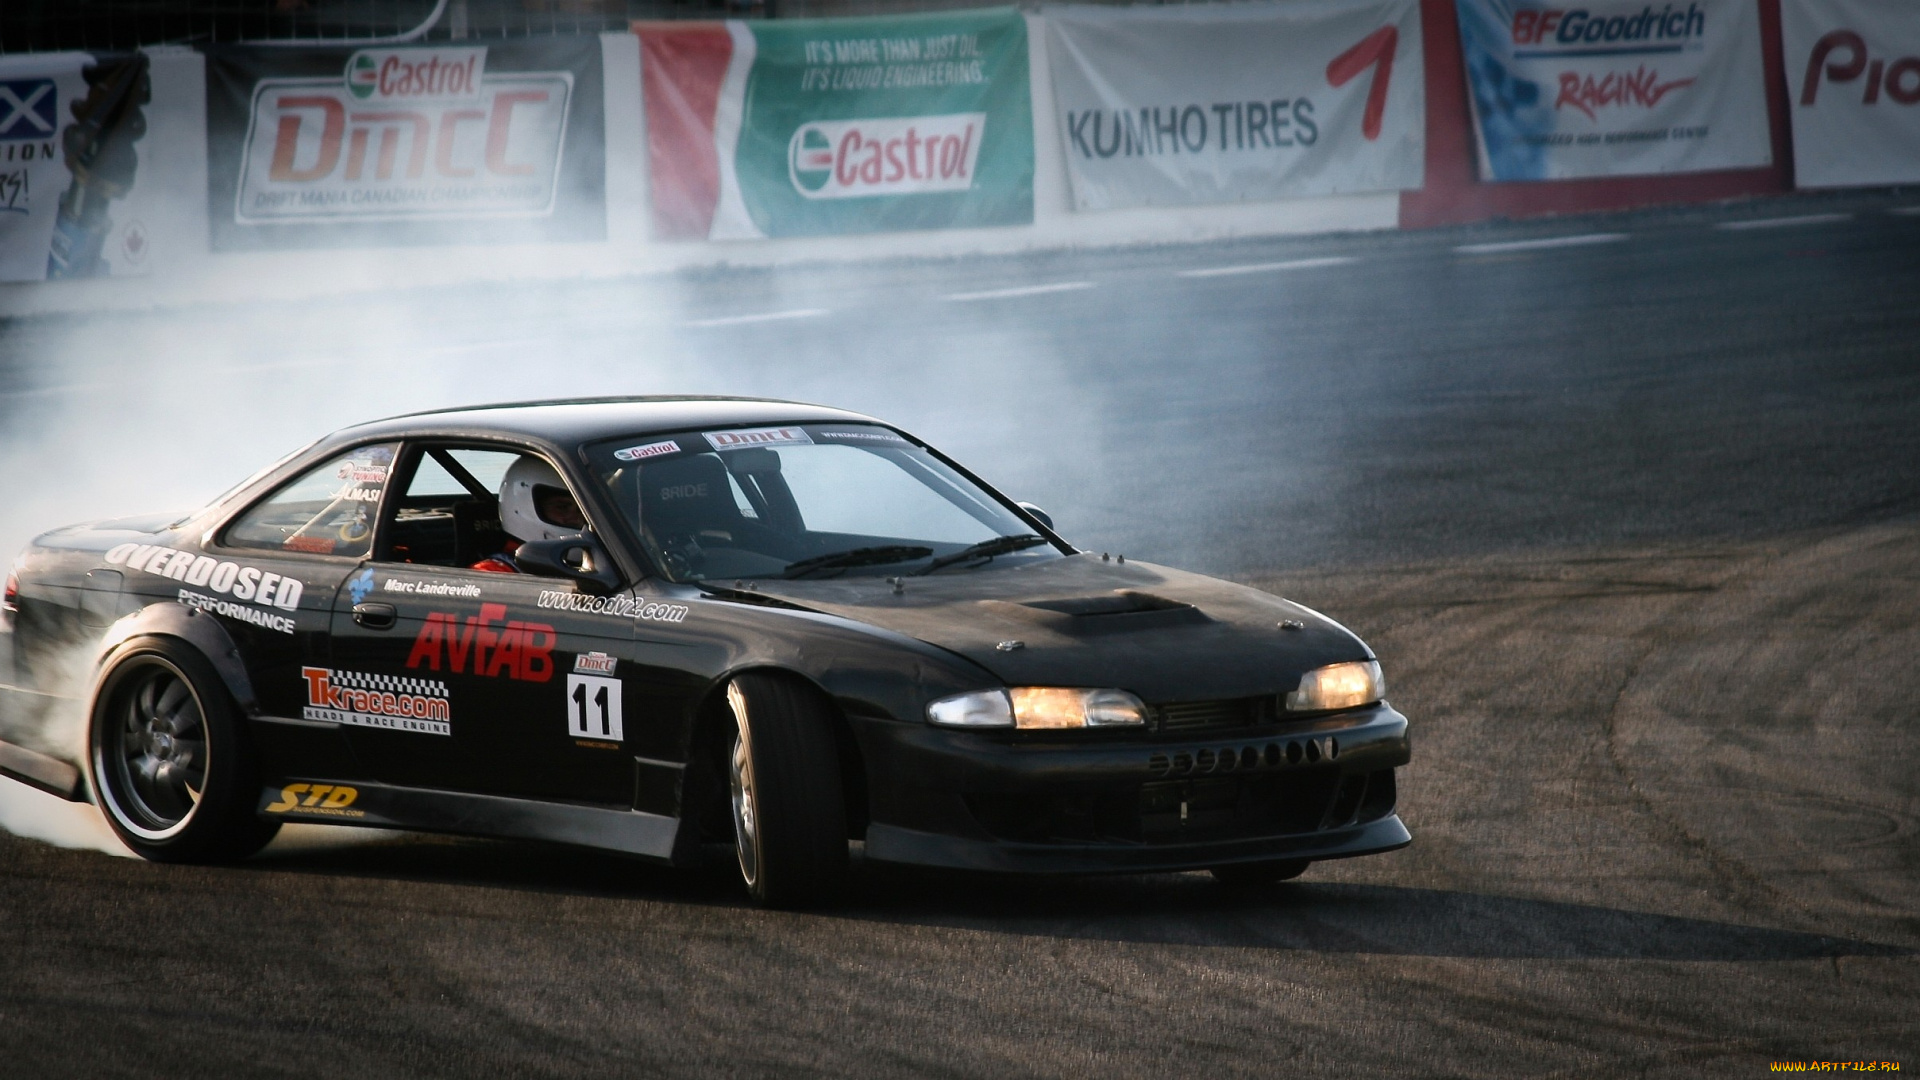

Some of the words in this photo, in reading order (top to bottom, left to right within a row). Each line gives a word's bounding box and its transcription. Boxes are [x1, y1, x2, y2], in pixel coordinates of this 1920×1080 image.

[1511, 4, 1704, 45] BFGoodrich
[804, 40, 833, 64] IT'S
[834, 38, 879, 63] MORE
[881, 37, 921, 61] THAN
[923, 34, 957, 59] JUST
[379, 54, 476, 97] Castrol
[801, 67, 831, 91] IT'S
[832, 65, 882, 90] LIQUID
[1555, 64, 1698, 122] RACING
[1068, 104, 1207, 160] KUMHO
[1209, 98, 1318, 152] TIRES
[835, 123, 975, 187] Castrol
[632, 443, 675, 459] Castrol
[661, 483, 708, 500] BRIDE
[104, 543, 303, 612] OVERDOSED
[384, 578, 413, 593] Marc
[415, 579, 481, 598] Landreville
[178, 589, 296, 635] PERFORMANCE
[405, 602, 557, 683] AVFAB
[366, 717, 395, 727] RACE
[572, 683, 610, 735] 11
[265, 783, 358, 813] STD
